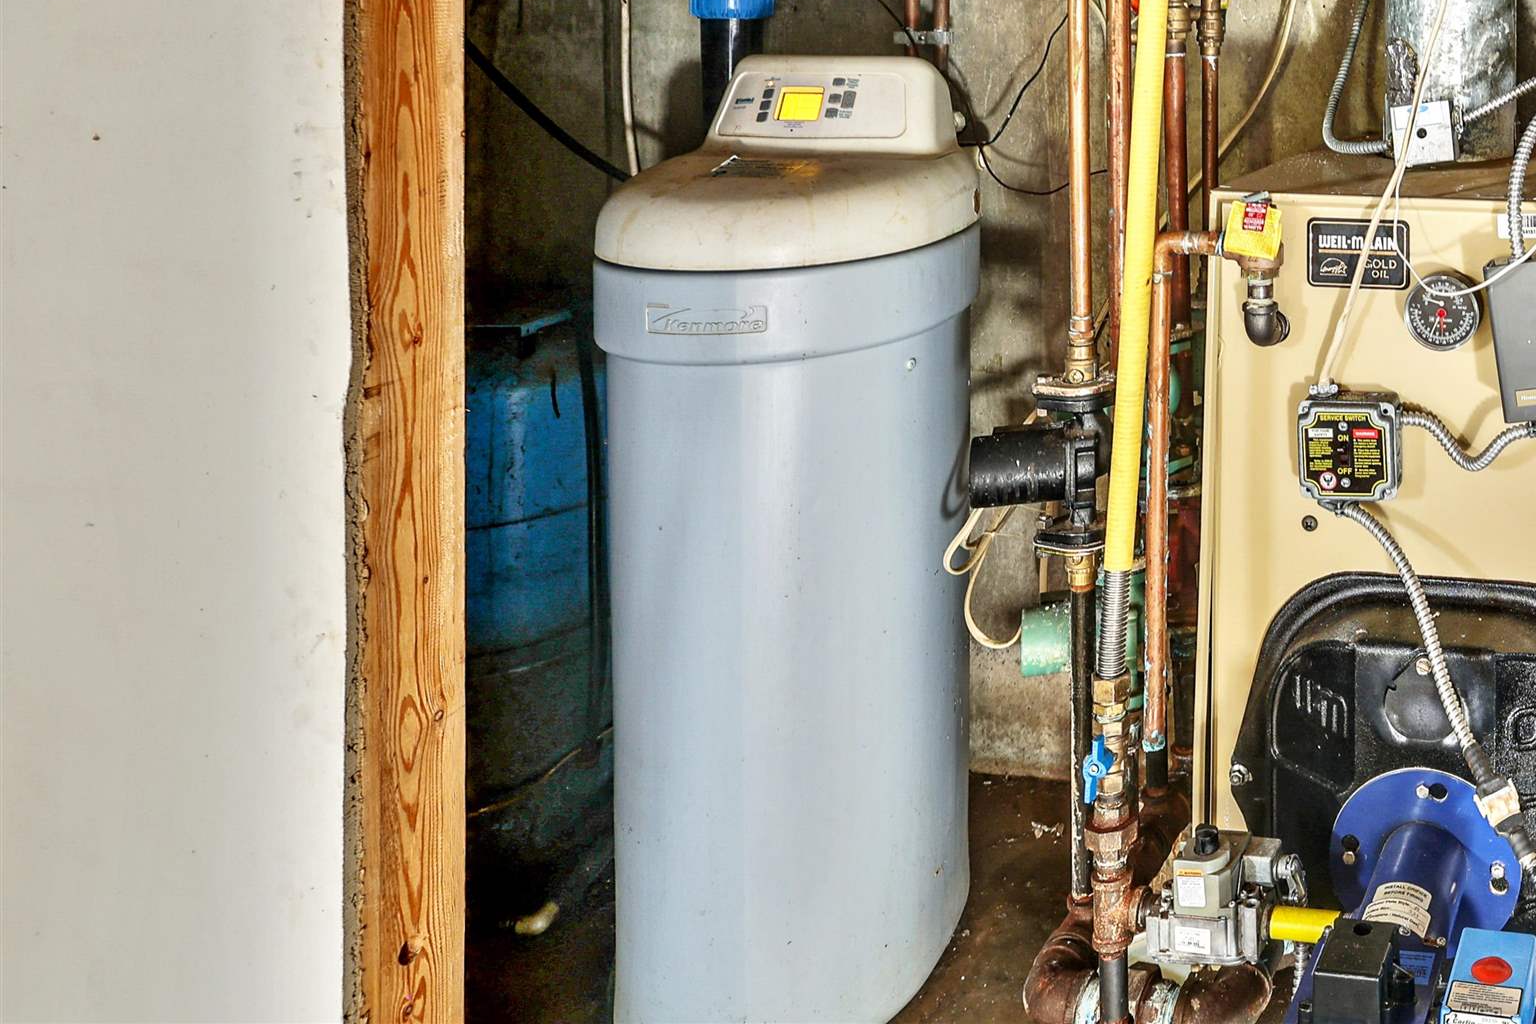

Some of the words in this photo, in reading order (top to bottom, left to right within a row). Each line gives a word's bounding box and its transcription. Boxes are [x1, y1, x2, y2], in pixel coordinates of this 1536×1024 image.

[1365, 258, 1397, 269] GOLD
[1371, 271, 1389, 279] OIL
[663, 317, 764, 332] Kenmore
[1320, 414, 1343, 422] SERVICE
[1337, 434, 1349, 442] ON
[1337, 467, 1352, 475] OFF
